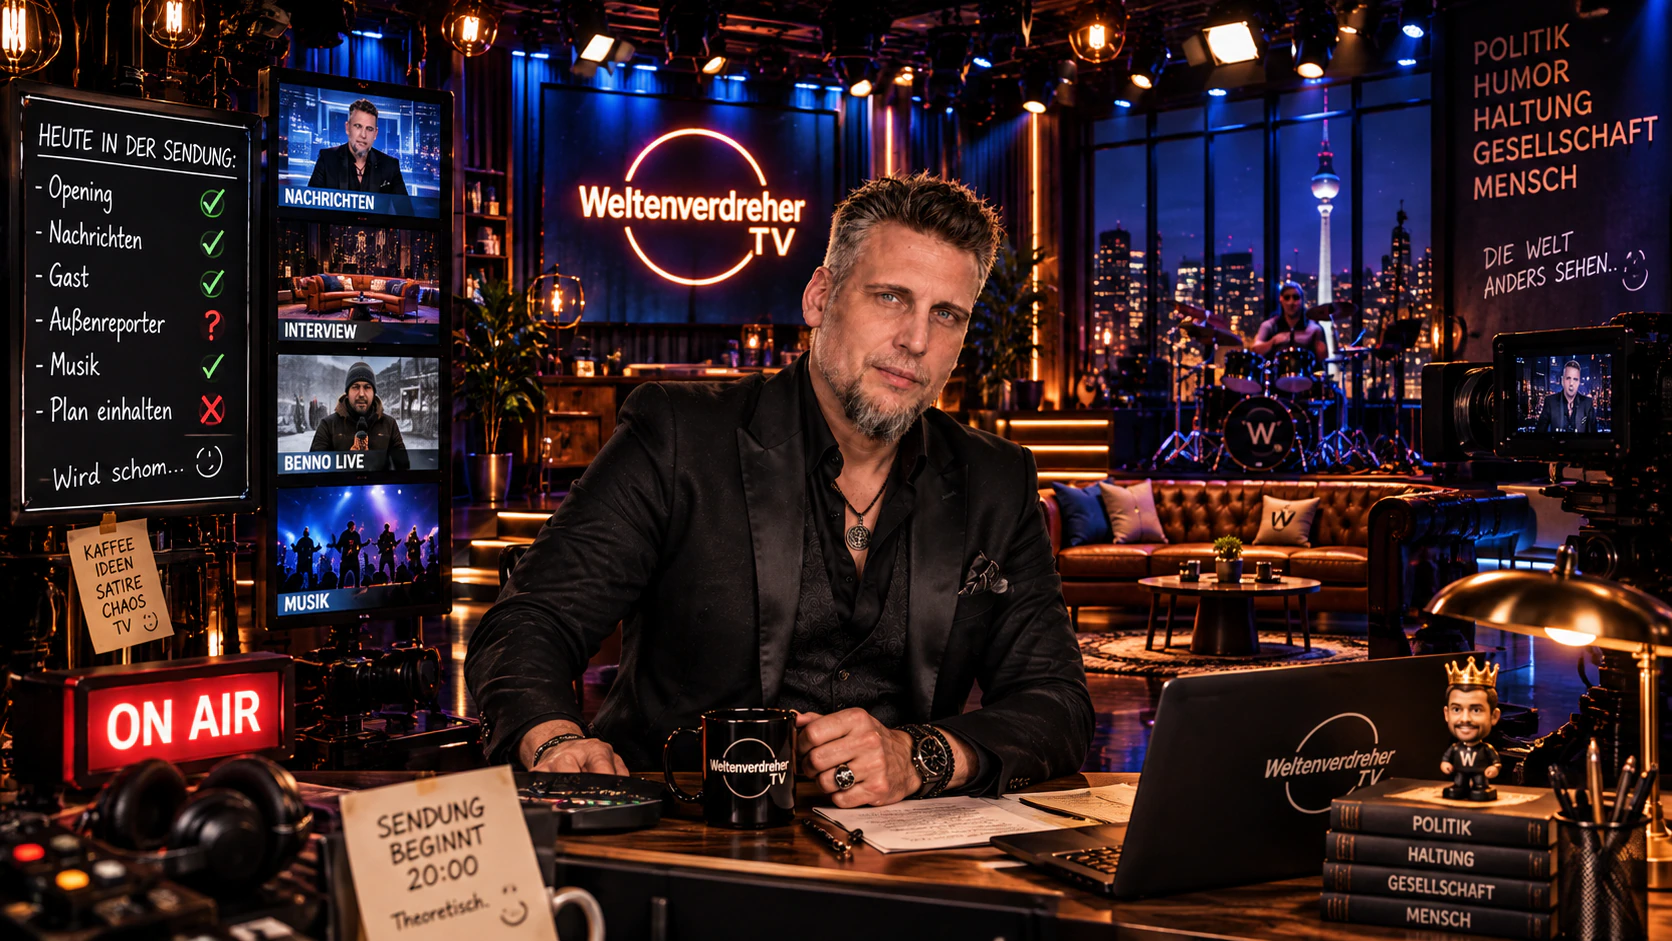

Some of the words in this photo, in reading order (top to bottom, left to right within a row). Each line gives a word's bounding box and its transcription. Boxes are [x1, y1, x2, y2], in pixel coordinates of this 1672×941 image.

[1474, 23, 1570, 65] POLITIK
[1474, 59, 1570, 98] HUMOR
[1474, 90, 1593, 132] HALTUNG
[39, 123, 93, 150] HEUTE
[102, 132, 118, 154] IN
[126, 135, 157, 158] DER
[163, 140, 236, 168] SENDUNG:
[1473, 115, 1659, 165] GESELLSCHAFT
[48, 173, 113, 214] Opening
[1474, 164, 1577, 200] MENSCH
[285, 187, 375, 210] NACHRICHTEN
[578, 184, 807, 223] Weltenverdreher
[49, 219, 142, 250] Nachrichten
[748, 227, 796, 257] TV
[1483, 243, 1514, 270] DIE
[1526, 230, 1575, 260] WELT
[49, 262, 90, 288] Gast
[1483, 266, 1546, 299] ANDERS
[49, 306, 166, 343] Außenreporter
[284, 321, 358, 340] INTERVIEW
[50, 351, 101, 376] Musik
[50, 395, 88, 423] Plan
[97, 396, 172, 421] einhalten
[53, 461, 101, 491] Wird
[284, 454, 332, 471] BENNO
[335, 453, 365, 470] LIVE
[83, 536, 135, 561] KAFFEE
[95, 555, 134, 578] IDEEN
[96, 574, 144, 600] SATIRE
[102, 594, 147, 619] CHAOS
[284, 592, 330, 612] MUSIK
[113, 618, 131, 635] TV
[107, 699, 173, 750] ON
[188, 690, 261, 741] AIR
[709, 758, 790, 774] Weltenverdreher
[1264, 748, 1396, 779] Weltenverdreher
[1459, 750, 1477, 767] W
[768, 771, 787, 786] TV
[1357, 768, 1385, 787] TV
[377, 796, 485, 839] SENDUNG
[1412, 815, 1472, 836] POLITIK
[389, 823, 485, 865] BEGINNT
[1408, 845, 1475, 867] HALTUNG
[406, 854, 479, 891] 20:00
[1387, 874, 1496, 900] GESELLSCHAFT
[391, 893, 490, 930] Theoretisch.
[1406, 906, 1471, 928] MENSCH
